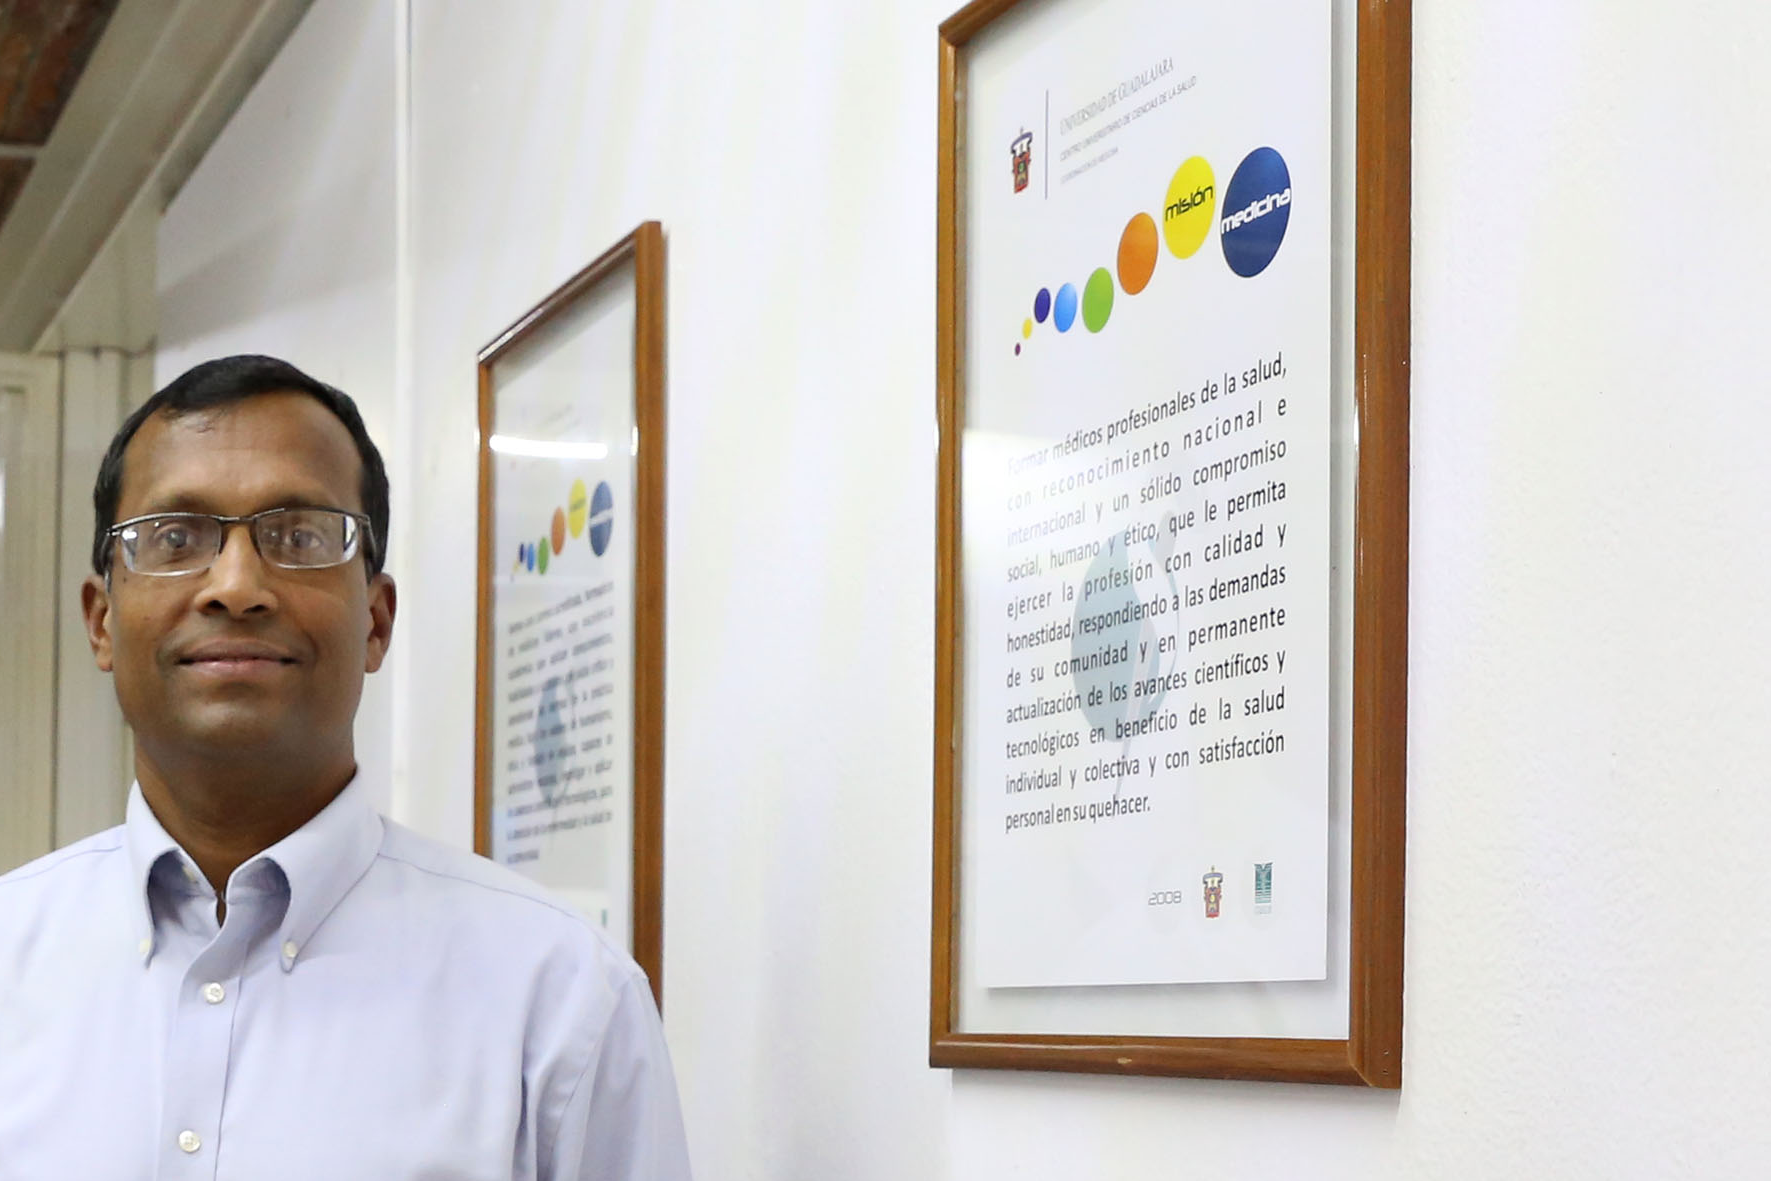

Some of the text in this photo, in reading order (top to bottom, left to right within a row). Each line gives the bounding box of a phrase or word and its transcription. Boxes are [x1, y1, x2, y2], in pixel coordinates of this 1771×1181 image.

[1118, 57, 1174, 101] GUADALAJARA
[1164, 185, 1213, 223] misión
[1221, 187, 1291, 235] medicina
[1007, 351, 1287, 477] Formar médicos profesionales de la salud,
[1007, 398, 1287, 512] con reconocimiento nacional e
[1007, 439, 1287, 547] internacional y un sólido compromiso
[1007, 481, 1287, 583] social, humano y ético, que le permita
[1007, 521, 1287, 619] ejercer la profesión con calidad y
[1007, 563, 1286, 653] honestidad, respondiendo a las demandas
[1007, 606, 1286, 688] de su comunidad y en permanente
[1006, 649, 1286, 724] actualización de los avances científicos y
[1006, 686, 1285, 760] tecnológicos en beneficio de la salud
[1006, 729, 1285, 796] individual y colectiva y con satisfacción
[1006, 794, 1151, 834] personal en su quehacer.
[1148, 890, 1182, 906] 2008
